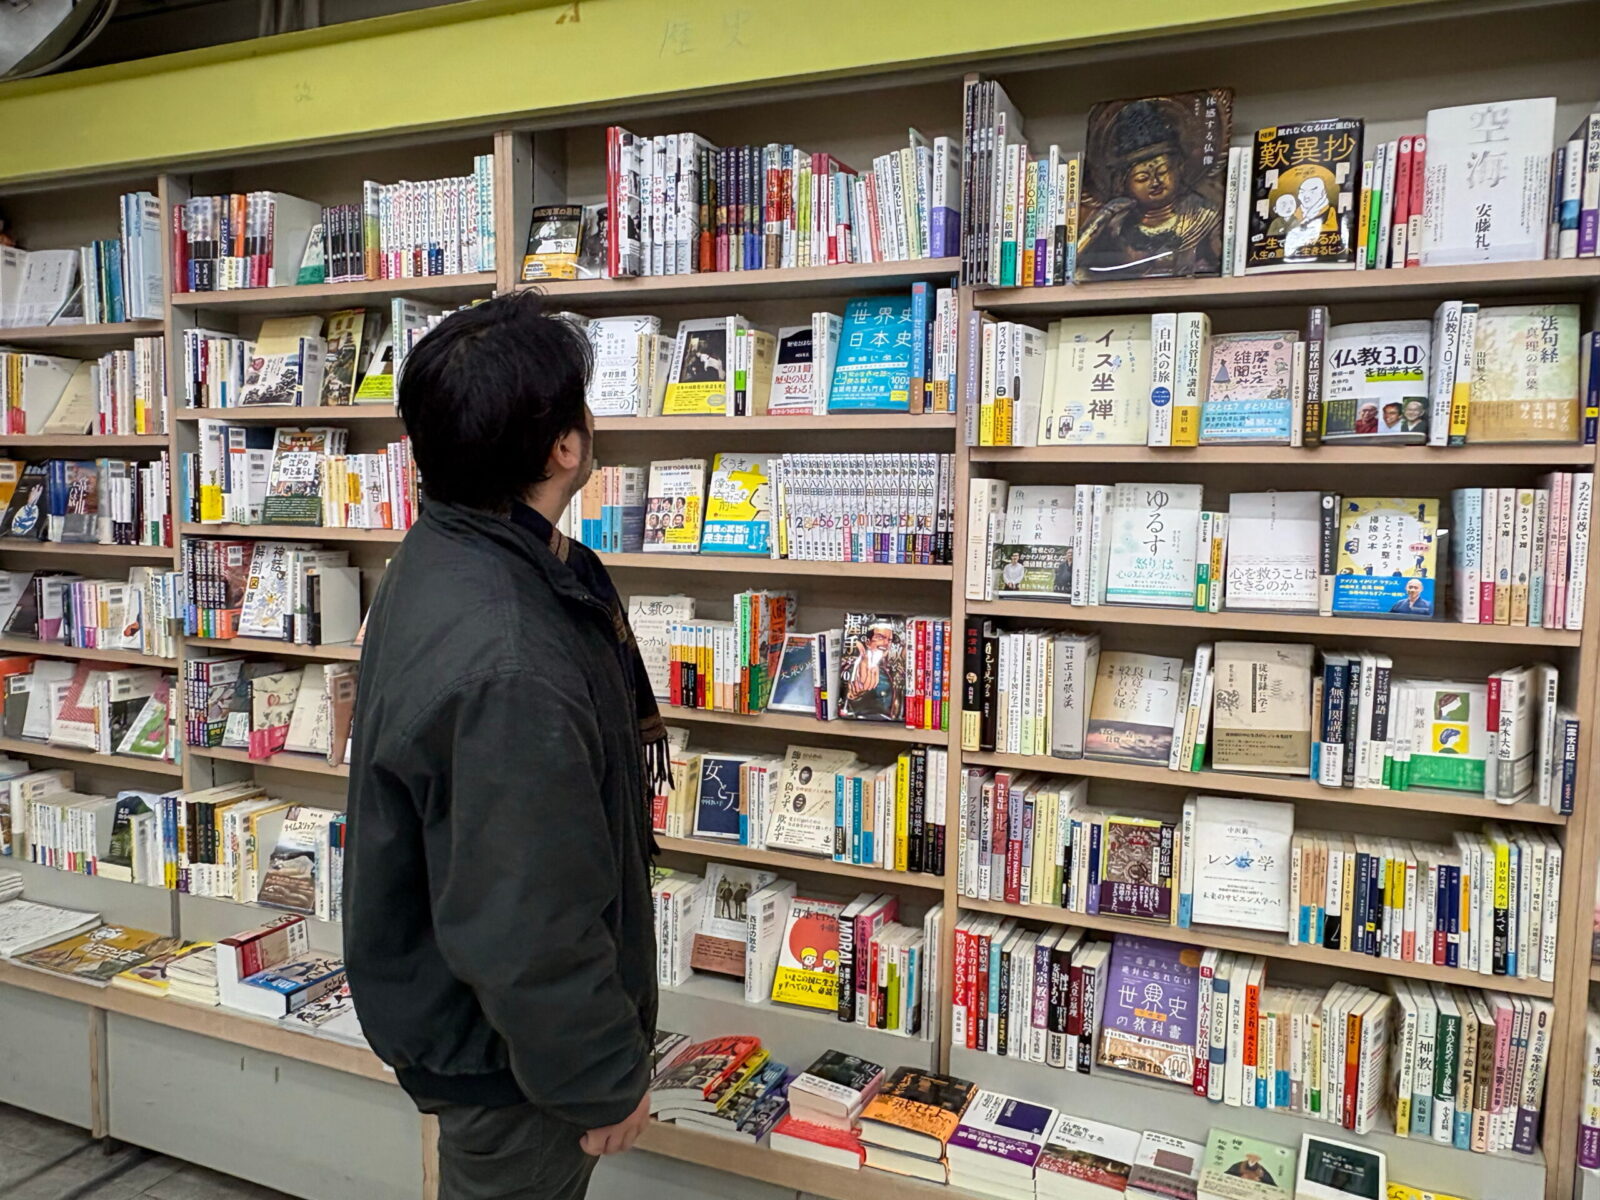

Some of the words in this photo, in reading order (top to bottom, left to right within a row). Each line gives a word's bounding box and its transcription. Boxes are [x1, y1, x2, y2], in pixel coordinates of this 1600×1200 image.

[1259, 132, 1357, 170] 歎異抄
[1468, 103, 1511, 191] 空海
[851, 306, 912, 325] 世界史
[849, 330, 912, 349] 日本史
[1158, 327, 1171, 383] 自由への旅
[1328, 344, 1427, 370] 〈仏教3.0〉
[1540, 315, 1559, 364] 法句経
[1088, 328, 1116, 421] イス坐禅
[1364, 366, 1424, 378] を哲学する
[288, 459, 309, 468] 江戸の
[1143, 489, 1170, 557] ゆるす
[1367, 515, 1379, 550] 掃除の本
[1501, 495, 1512, 538] おうちで禅
[1519, 507, 1529, 549] おうちで禅
[1381, 516, 1392, 569] こころが整う
[1229, 566, 1318, 581] 心を救うことは
[1229, 579, 1295, 592] できるのか
[634, 601, 675, 616] 人類の
[1499, 716, 1513, 759] 鈴木大拙
[1160, 827, 1172, 877] 輪廻の思想
[1207, 851, 1275, 872] レンマ学
[954, 932, 967, 1006] 歎異抄をひらく
[967, 939, 977, 984] 人生の目的
[1121, 965, 1192, 986] 絶対に忘れない
[1033, 971, 1048, 1026] 宗教原論
[1117, 982, 1188, 1021] 世界史
[1116, 1014, 1183, 1041] の教科書
